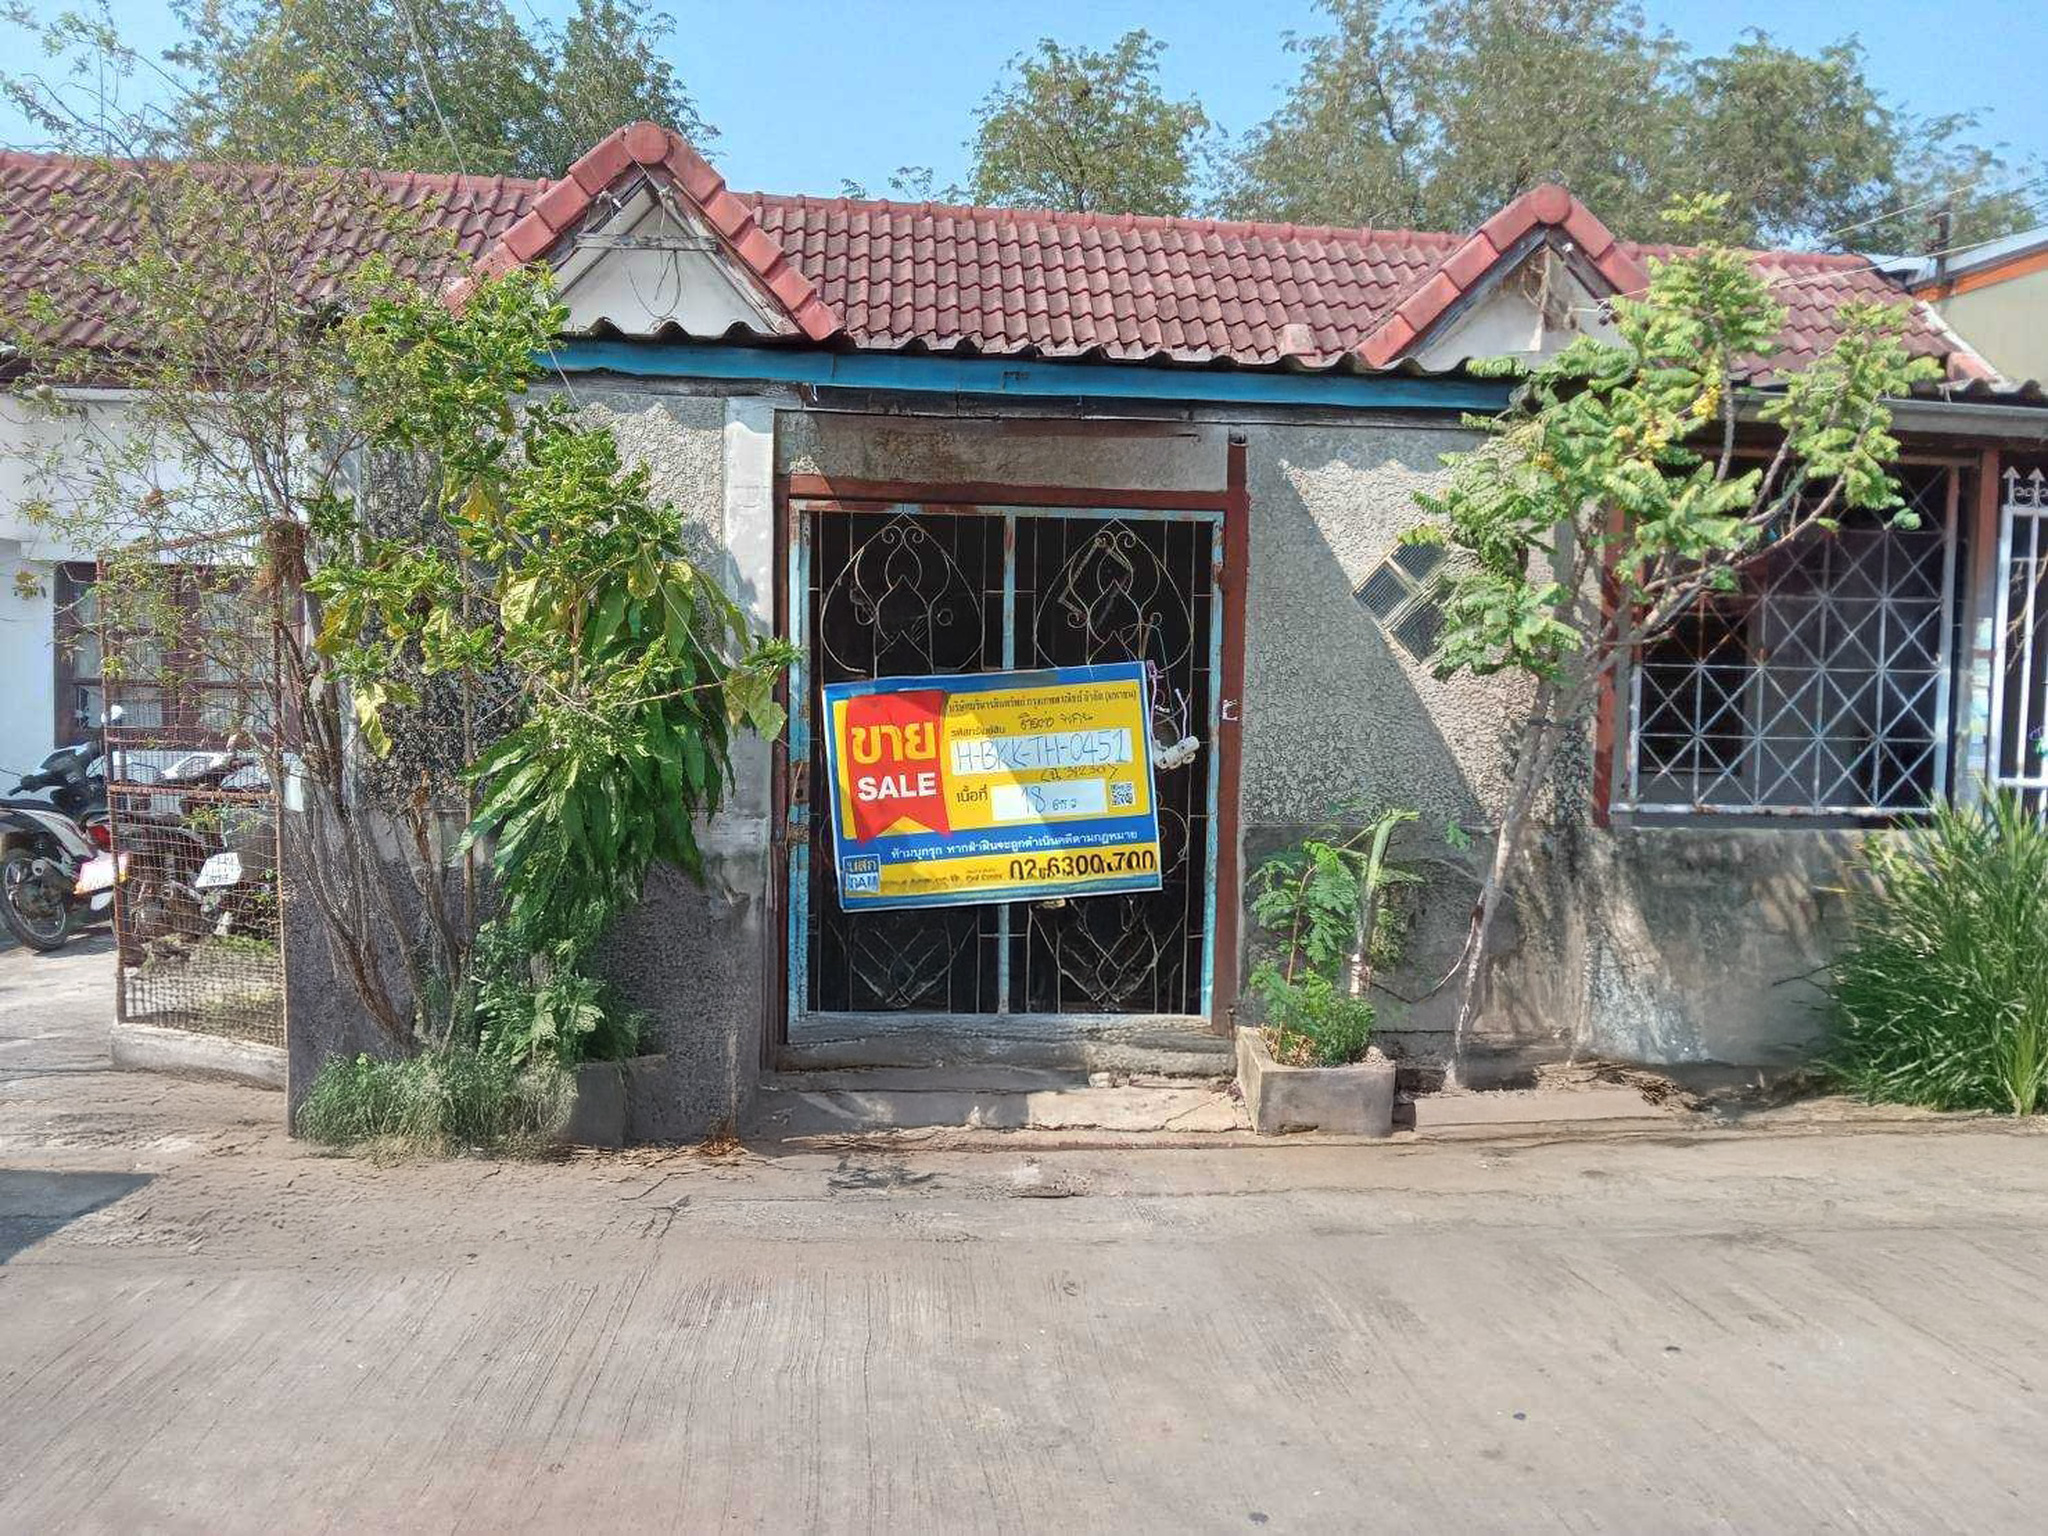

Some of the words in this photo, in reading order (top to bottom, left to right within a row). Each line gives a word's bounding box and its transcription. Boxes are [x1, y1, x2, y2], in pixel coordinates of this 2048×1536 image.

[850, 721, 936, 765] ขาย
[857, 771, 937, 801] SALE
[956, 784, 988, 803] เนื้อที่
[1021, 785, 1046, 814] 18
